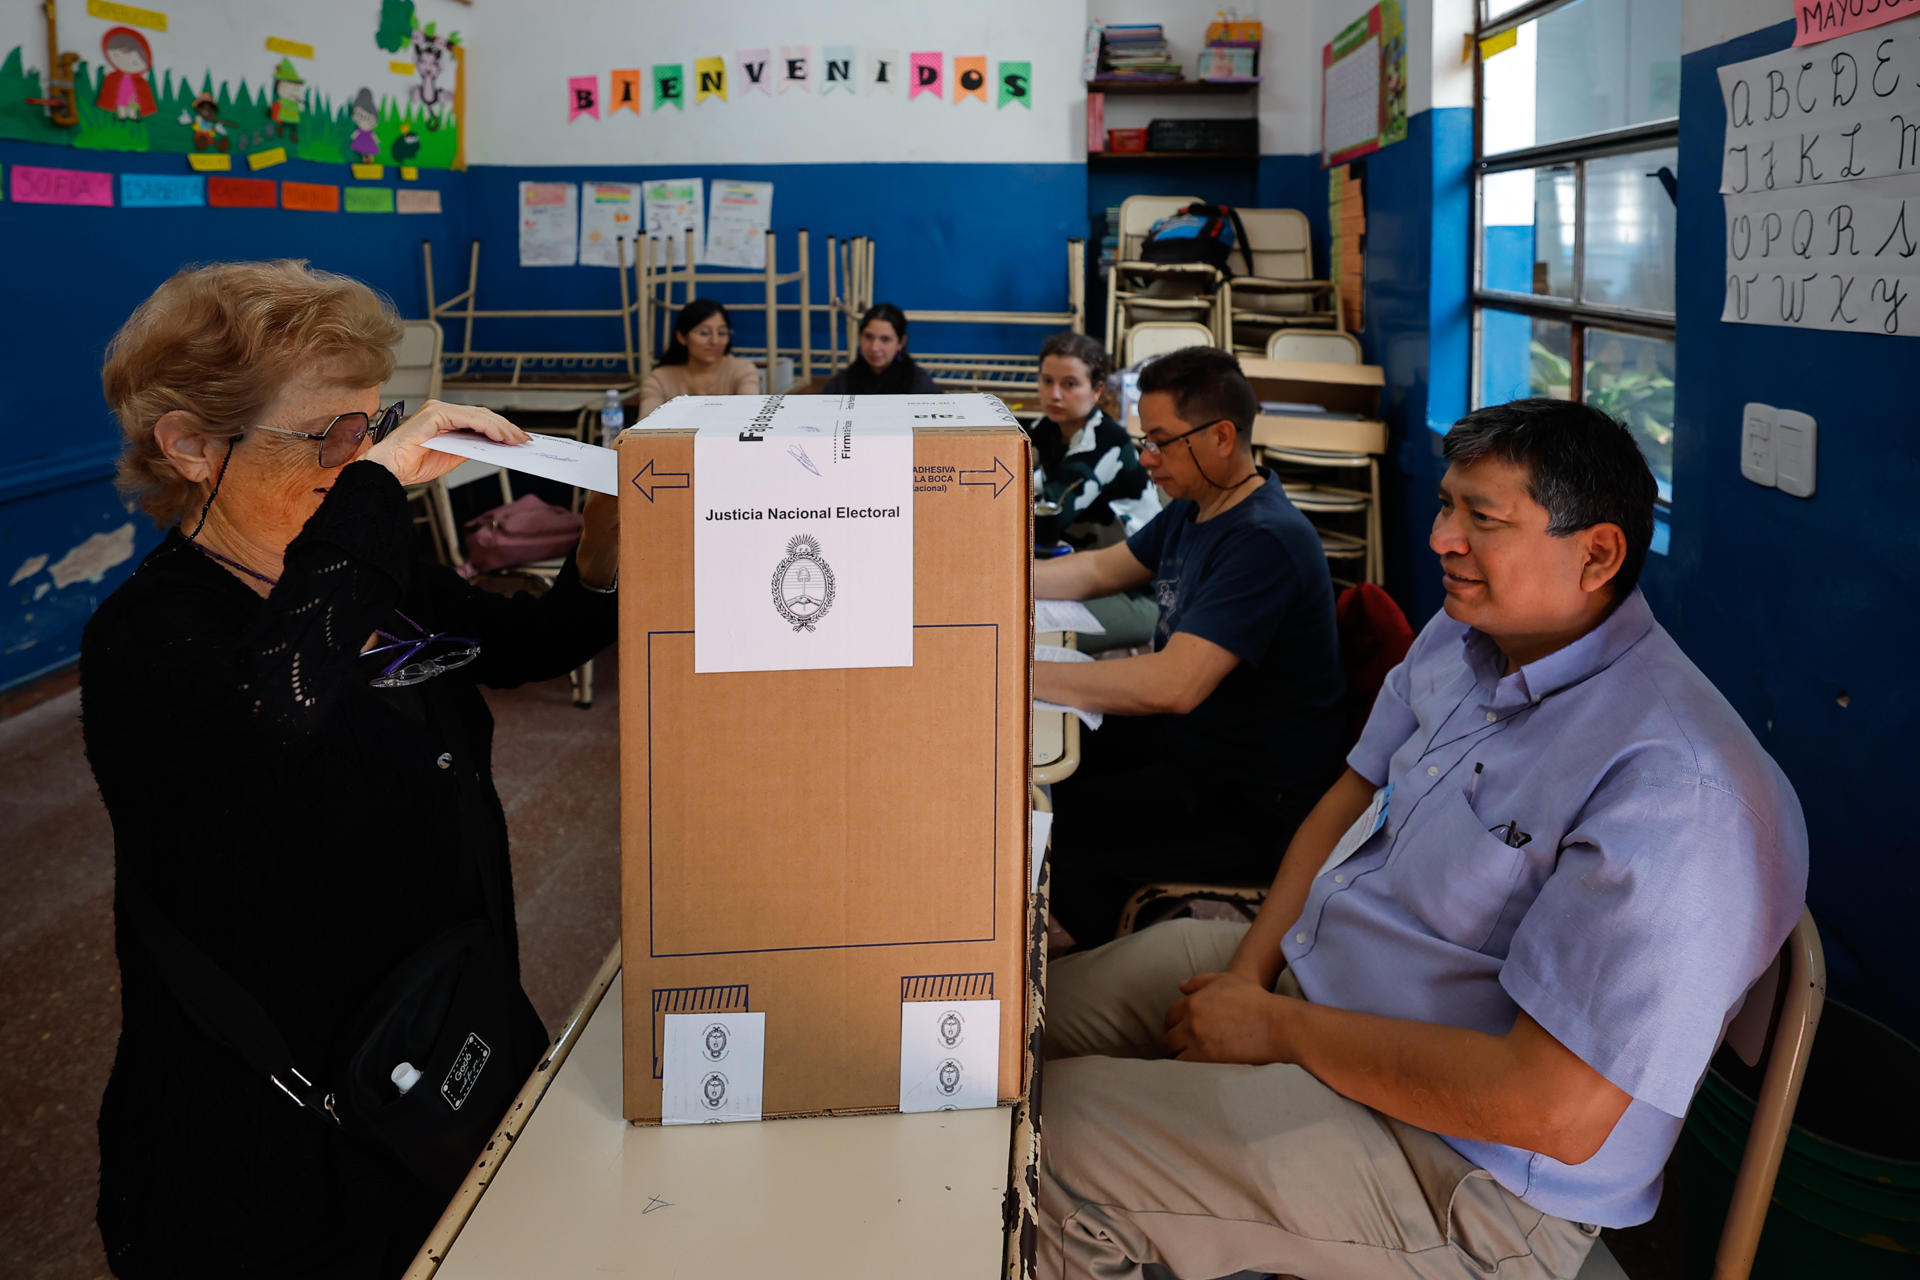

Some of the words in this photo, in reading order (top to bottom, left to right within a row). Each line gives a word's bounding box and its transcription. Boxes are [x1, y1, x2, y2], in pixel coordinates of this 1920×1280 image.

[575, 57, 1029, 110] BIENVENIDOS
[1764, 70, 1790, 121] B
[1796, 62, 1817, 113] C
[1831, 52, 1858, 107] D
[1872, 39, 1900, 97] E
[1795, 133, 1823, 184] K
[1840, 122, 1866, 178] L
[1731, 214, 1751, 261] O
[1761, 212, 1782, 257] P
[1792, 209, 1814, 259] Q
[1828, 205, 1860, 256] R
[1830, 275, 1857, 324] X
[739, 423, 774, 442] Faja
[705, 509, 763, 521] Justicia
[768, 507, 831, 520] Nacional
[836, 506, 900, 518] Electoral
[913, 484, 947, 493] acional)
